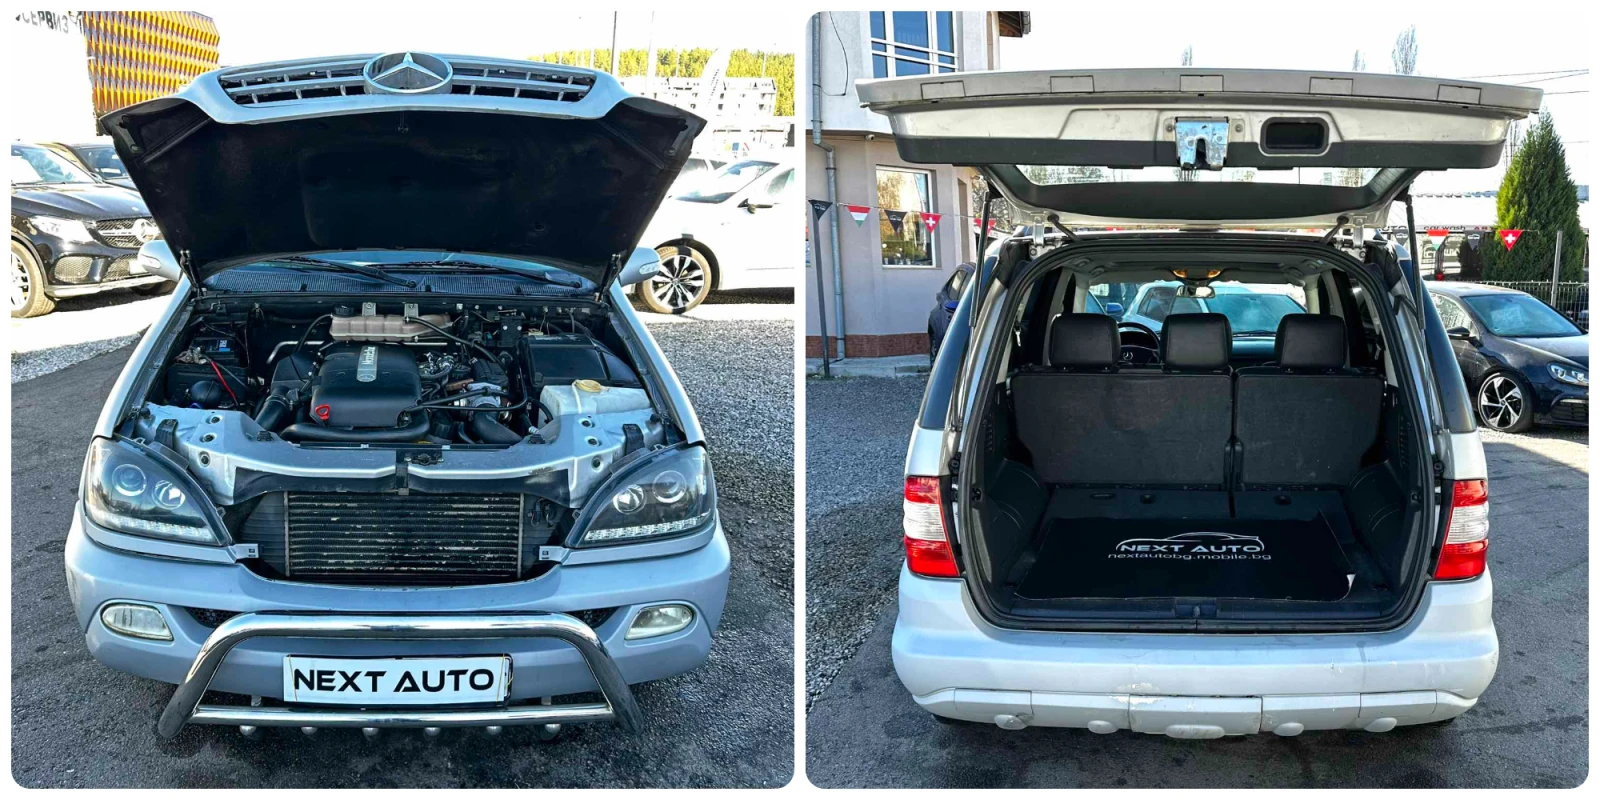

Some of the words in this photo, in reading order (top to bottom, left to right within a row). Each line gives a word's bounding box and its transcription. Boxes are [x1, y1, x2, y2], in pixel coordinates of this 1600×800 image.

[1120, 544, 1185, 552] NEXT
[1190, 544, 1261, 553] AUTO
[1107, 553, 1272, 561] nextautobg.mobile.bg
[294, 668, 388, 693] NEXT
[392, 668, 495, 693] AUTO
